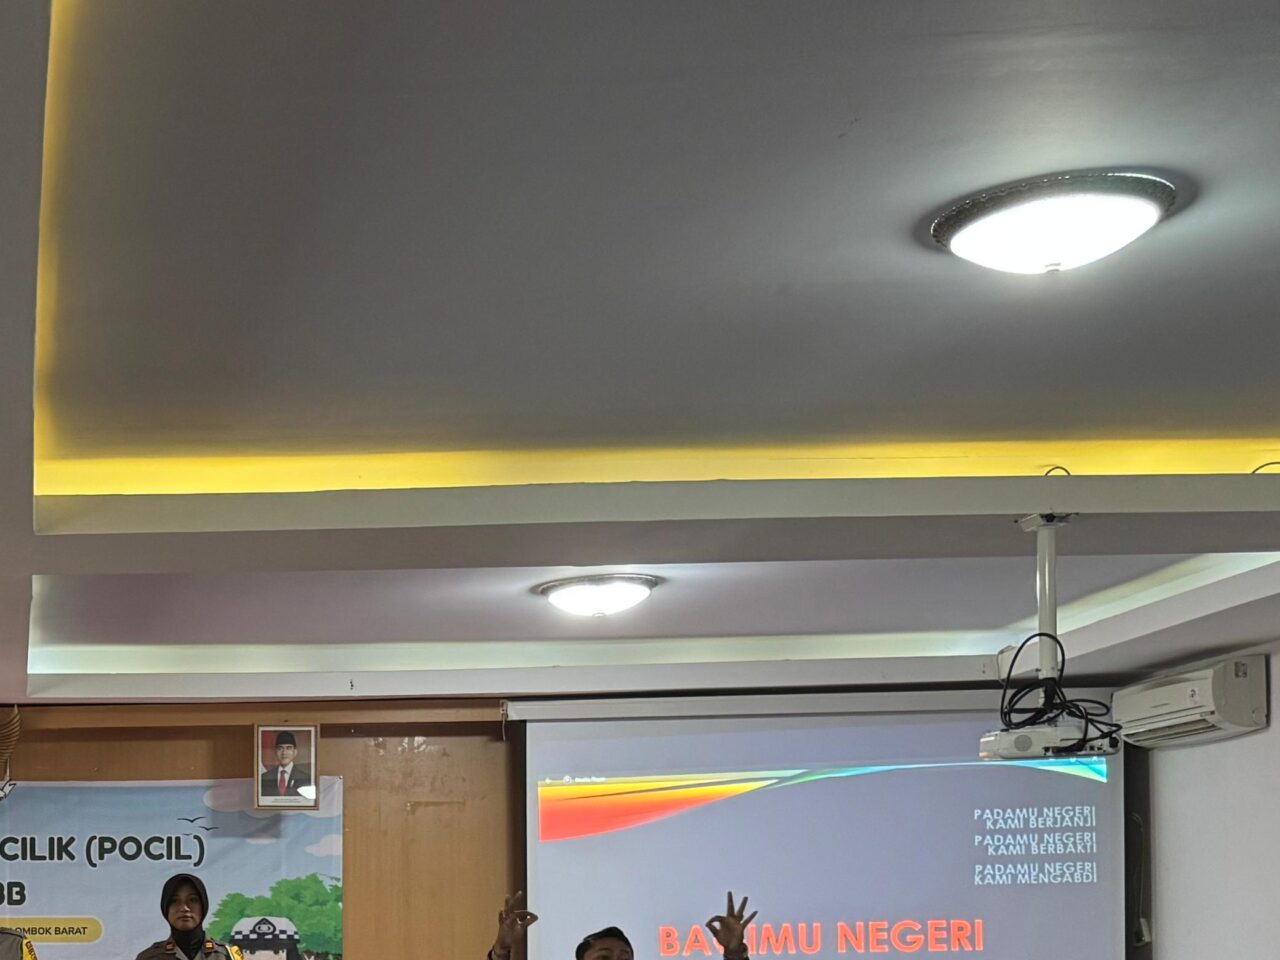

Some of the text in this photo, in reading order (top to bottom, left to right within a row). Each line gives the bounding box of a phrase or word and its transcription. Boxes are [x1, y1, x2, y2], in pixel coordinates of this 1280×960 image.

[973, 806, 1096, 820] PADAMU NEGERI
[985, 816, 1096, 829] KAMI BERJANJI
[974, 832, 1096, 846] PADAMU NEGERI
[85, 835, 205, 868] (POCIL)
[986, 841, 1097, 856] KAMI BERBAKTI
[974, 862, 1097, 876] PADAMU NEGERI
[973, 872, 1097, 885] KAMI MENGABDI
[14, 926, 52, 936] OMBOK
[54, 926, 88, 935] BARAT
[658, 919, 984, 957] BAIMU NEGERI
